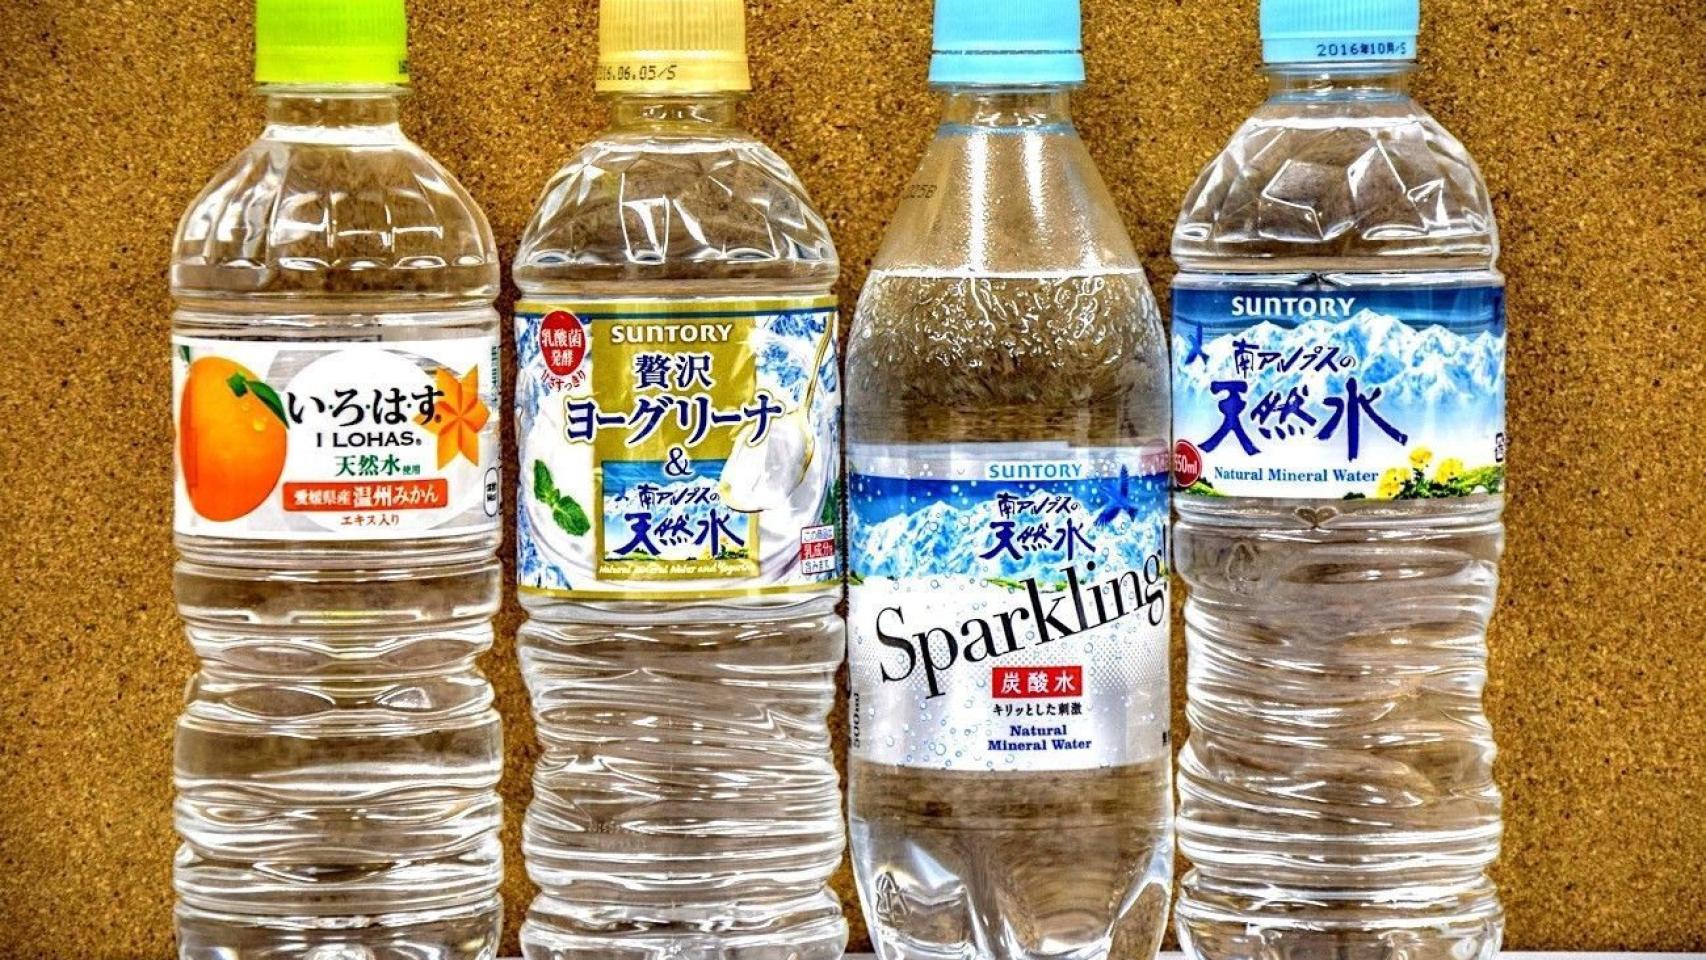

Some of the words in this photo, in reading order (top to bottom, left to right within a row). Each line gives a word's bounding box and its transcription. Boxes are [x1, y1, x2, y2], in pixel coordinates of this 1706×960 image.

[1232, 296, 1355, 317] SUNTORY
[541, 328, 582, 348] 乳酸菌
[611, 323, 732, 343] SUNTORY
[1232, 338, 1356, 378] 南アルプスの
[635, 354, 713, 389] 贅沢
[567, 395, 783, 444] ヨーグリーナ
[1198, 377, 1408, 462] 天然水
[665, 447, 692, 476] &
[989, 464, 1082, 479] SUNTORY
[1214, 467, 1263, 481] Natural
[1268, 468, 1328, 482] Mineral
[1333, 469, 1379, 482] Water
[638, 484, 720, 510] 南アルプスの
[997, 492, 1080, 519] 南アルプスの
[340, 514, 400, 527] エキス入り
[613, 508, 745, 556] 天然水
[979, 518, 1096, 560] 天然水
[1000, 670, 1077, 694] 炭酸水
[993, 702, 1082, 716] キリッとした刺激
[1010, 724, 1068, 737] Natural
[988, 740, 1047, 751] Mineral
[1051, 739, 1092, 751] Water
